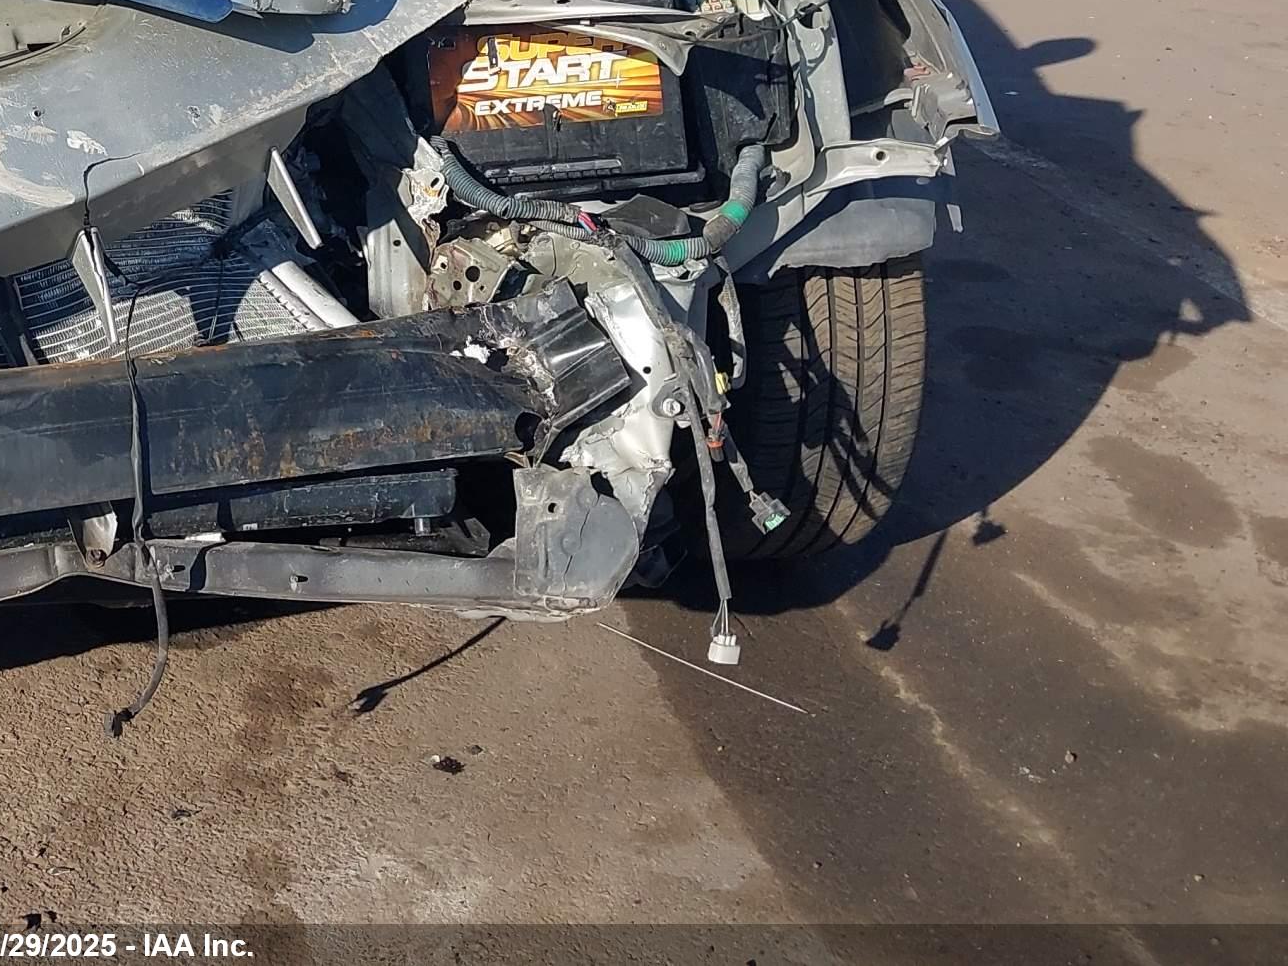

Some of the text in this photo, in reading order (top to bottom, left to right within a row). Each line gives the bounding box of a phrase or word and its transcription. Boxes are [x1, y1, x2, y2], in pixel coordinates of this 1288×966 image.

[477, 32, 626, 61] SUPER
[457, 48, 627, 93] START
[474, 90, 604, 116] EXTREME
